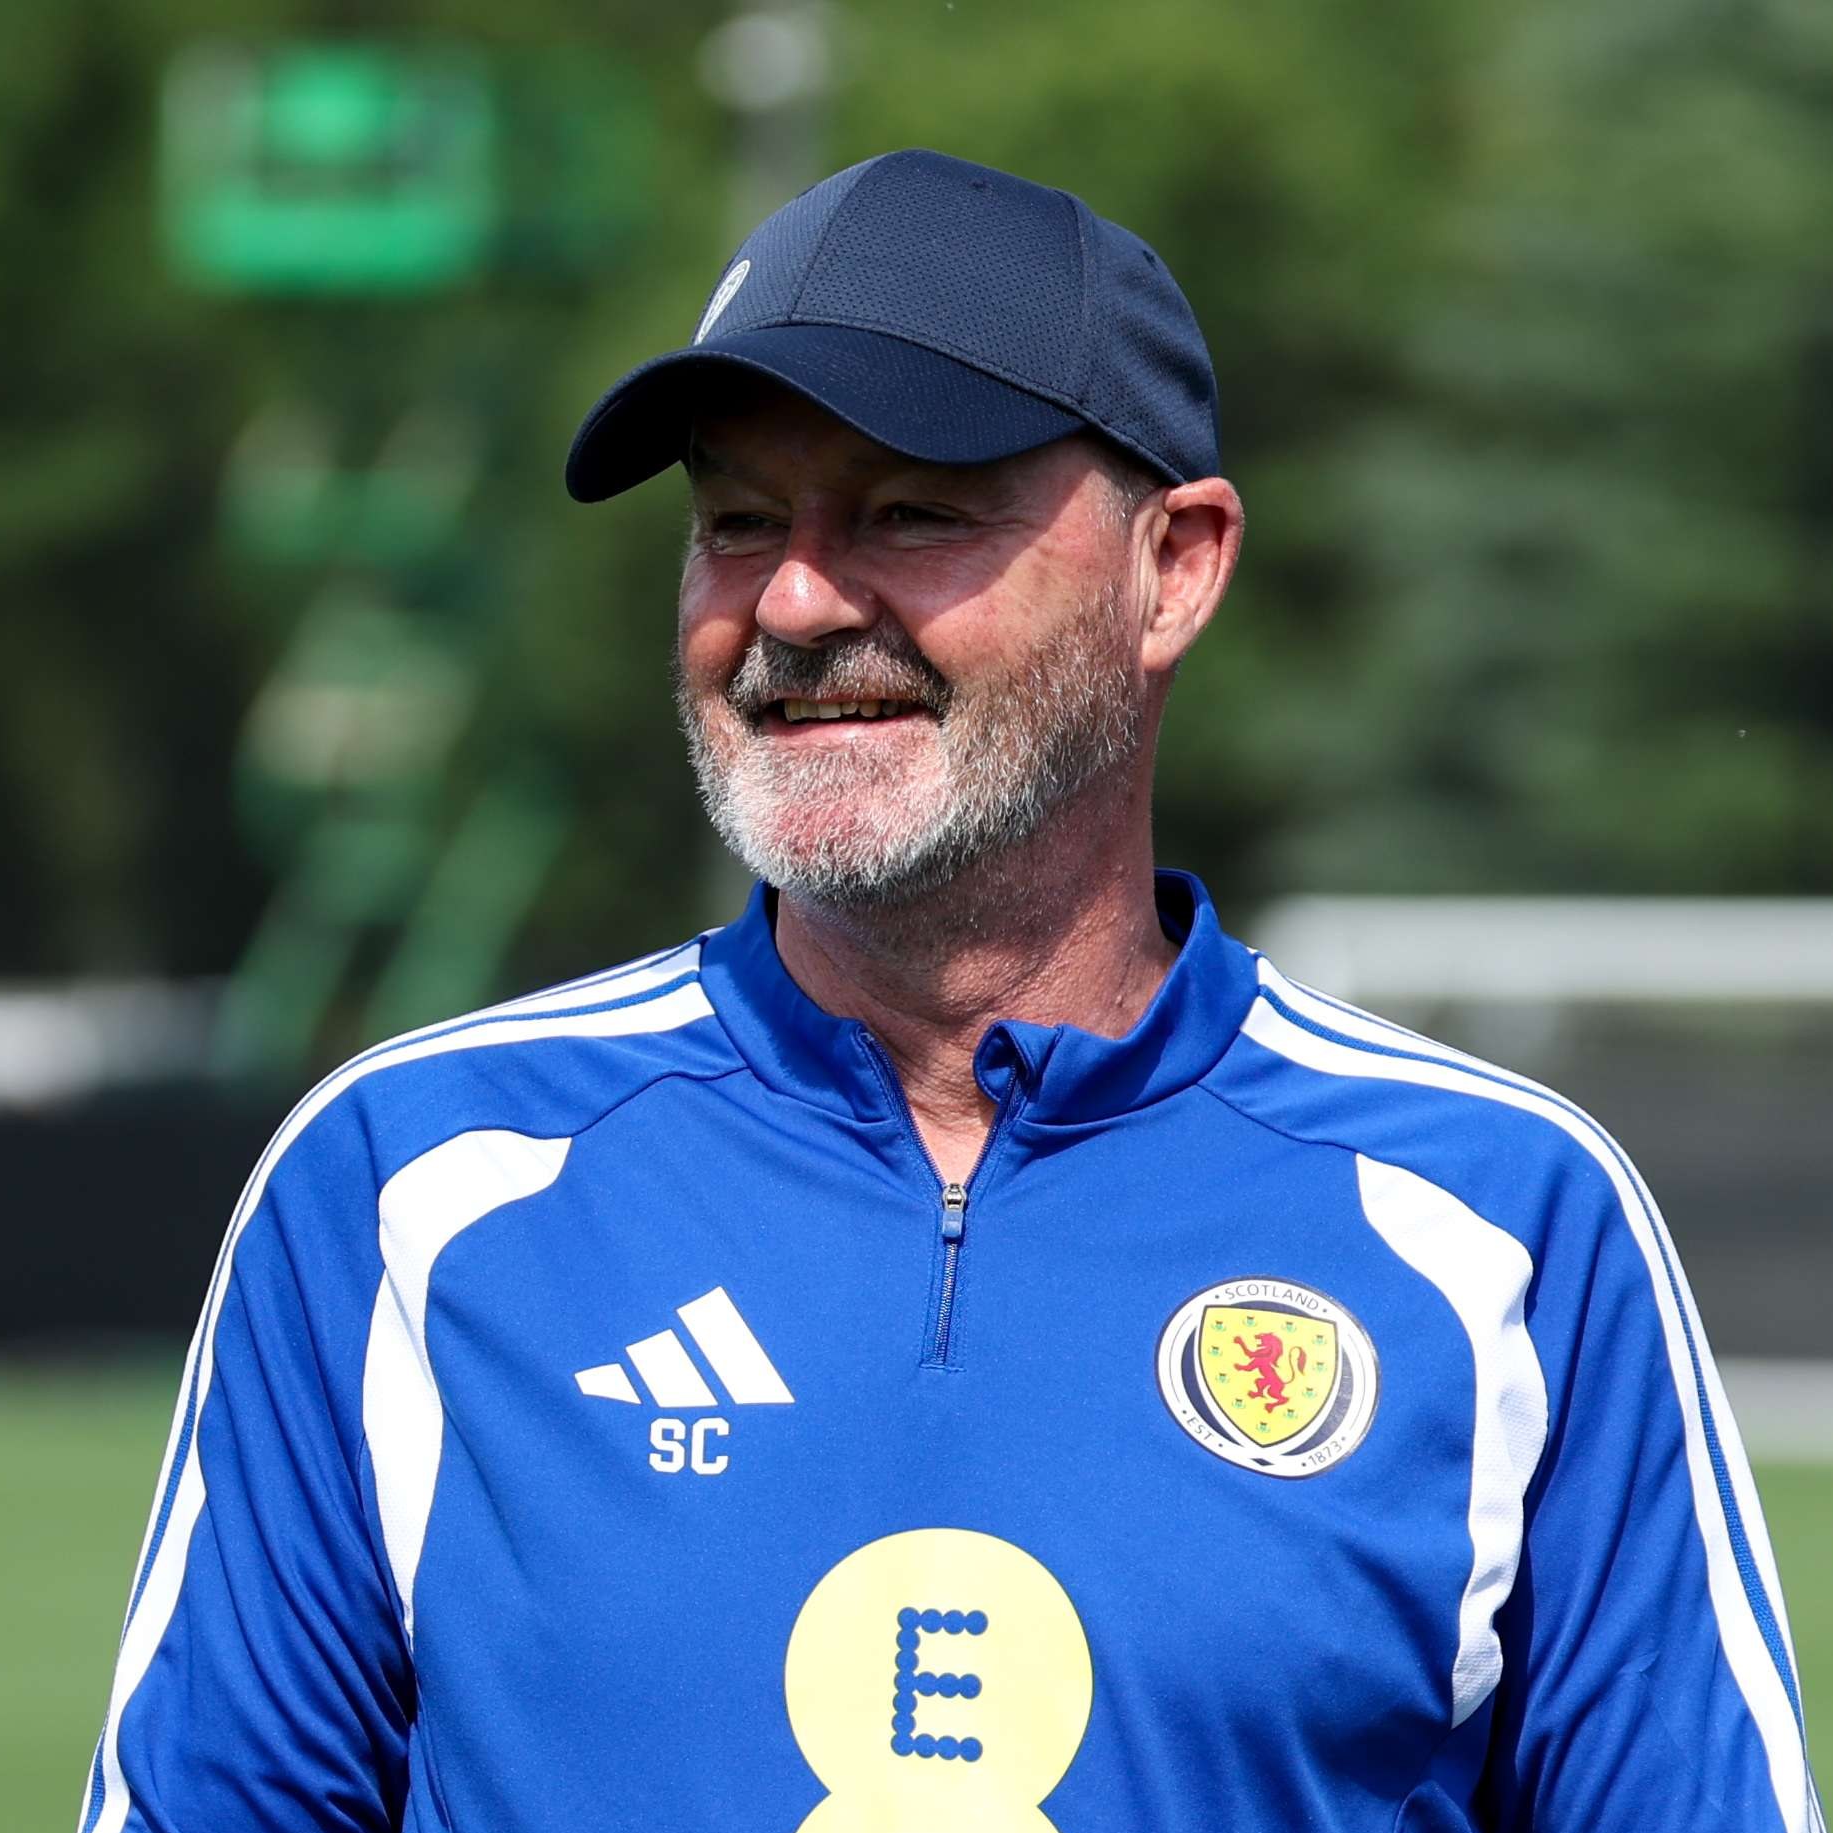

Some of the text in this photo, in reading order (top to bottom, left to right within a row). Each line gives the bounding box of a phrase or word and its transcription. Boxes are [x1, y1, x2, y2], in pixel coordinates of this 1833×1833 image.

[1225, 1284, 1319, 1311] SCOTLAND
[1187, 1416, 1214, 1442] EST
[649, 1417, 730, 1475] SC
[1309, 1440, 1342, 1466] 1873
